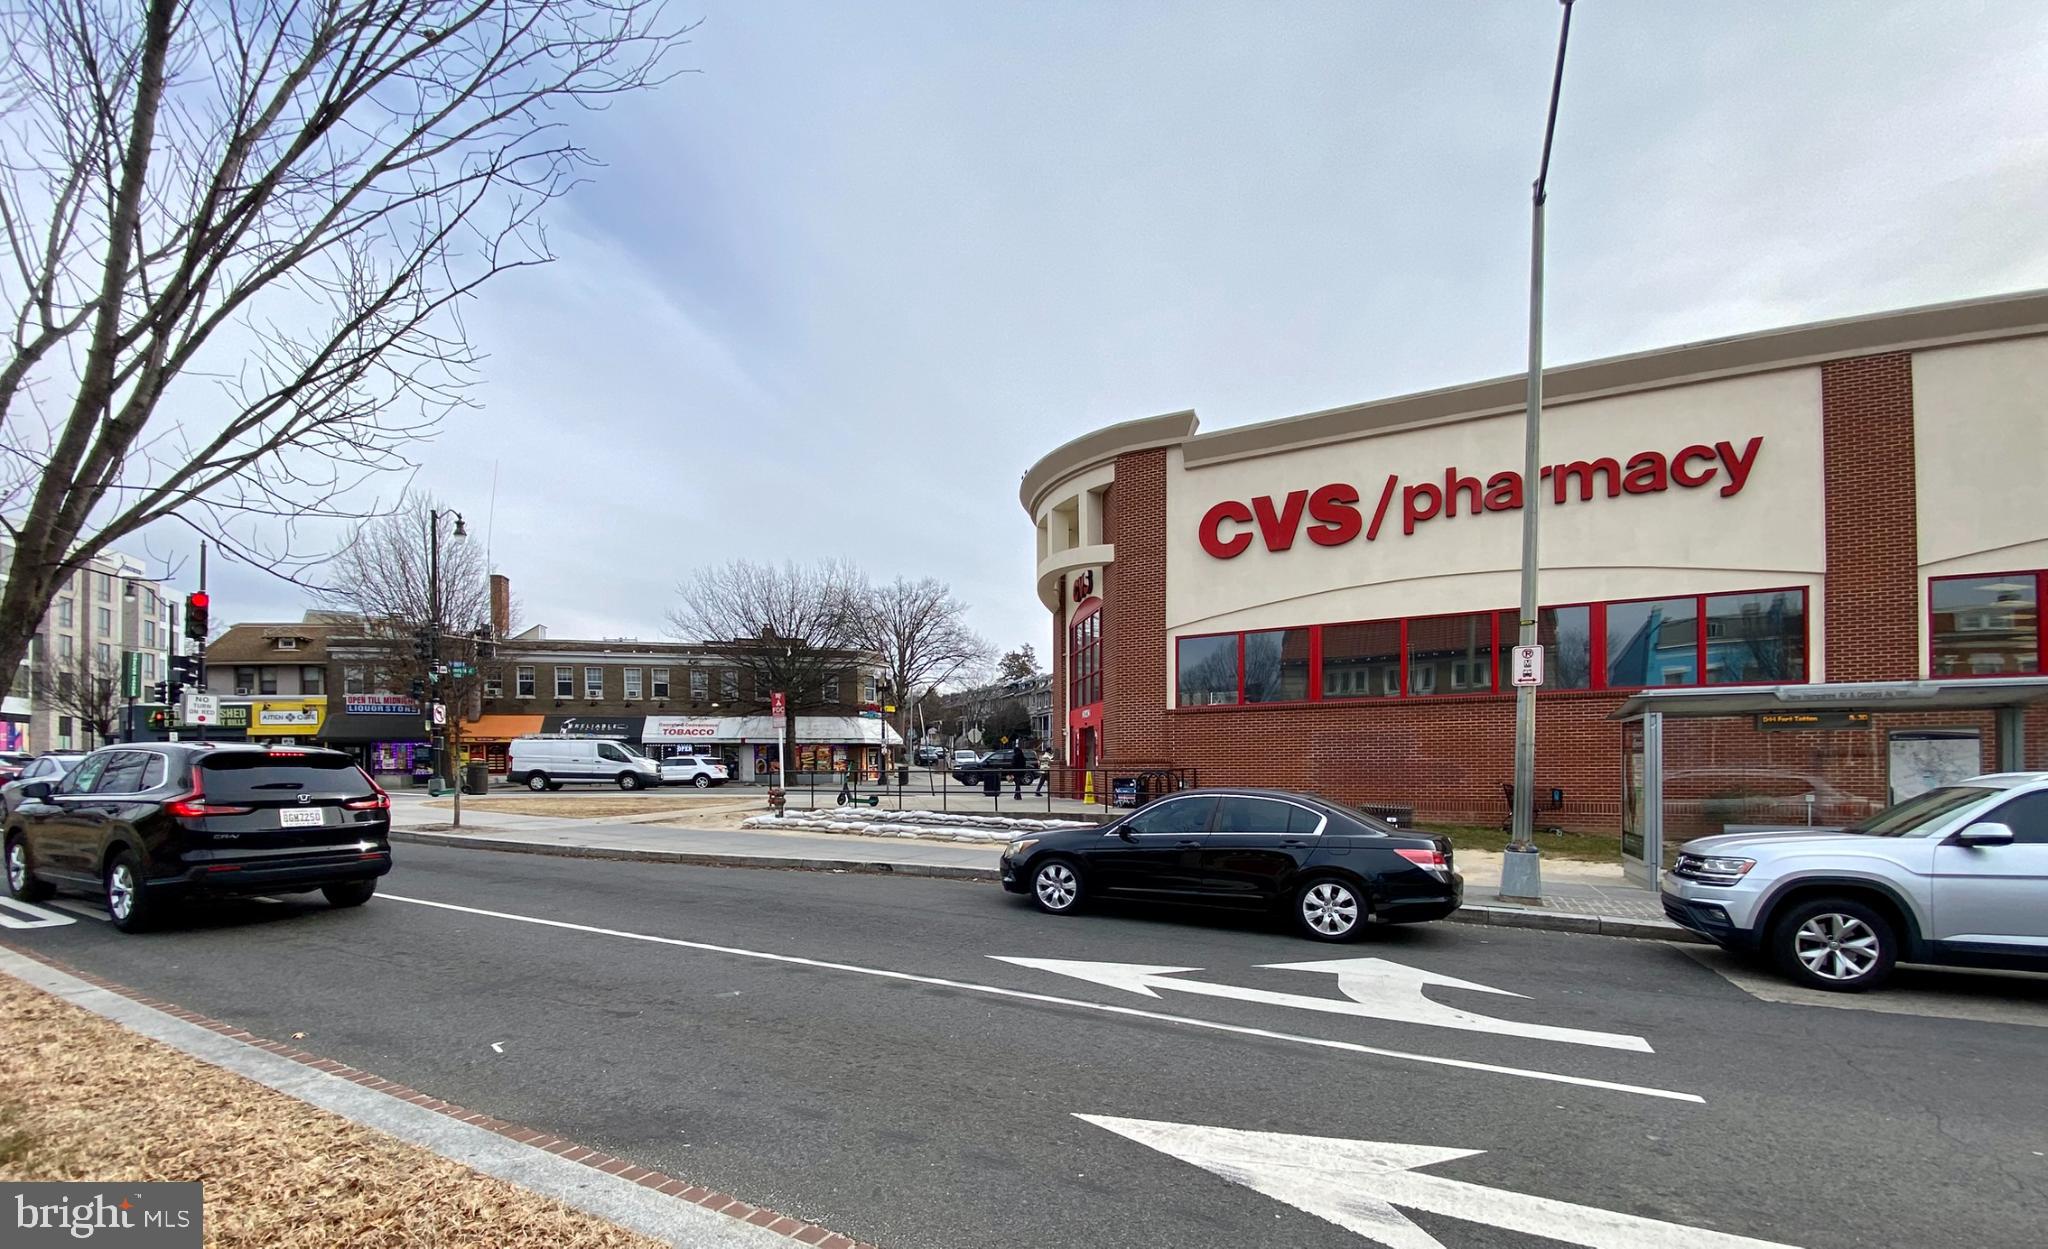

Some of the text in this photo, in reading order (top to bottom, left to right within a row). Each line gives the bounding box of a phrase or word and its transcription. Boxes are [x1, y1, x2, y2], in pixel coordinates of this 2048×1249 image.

[1199, 436, 1764, 560] CVS/phamacy
[348, 696, 366, 704] OPEN
[368, 696, 381, 704] TILL
